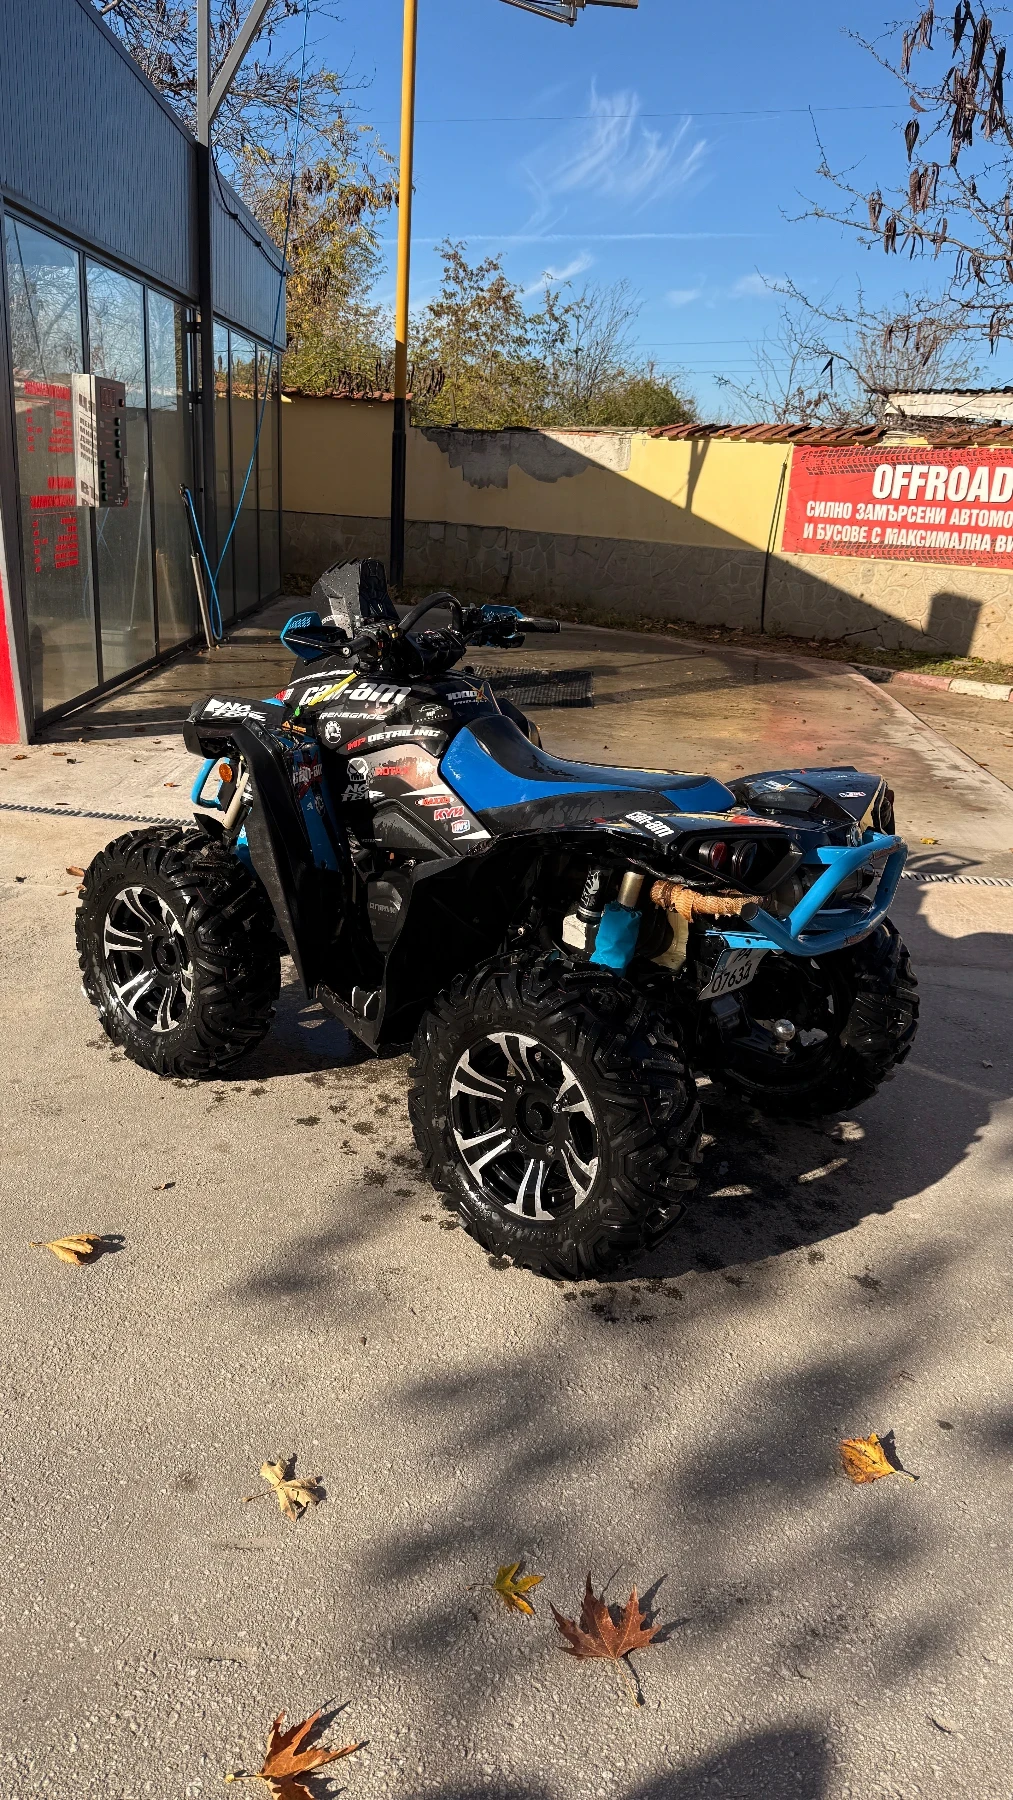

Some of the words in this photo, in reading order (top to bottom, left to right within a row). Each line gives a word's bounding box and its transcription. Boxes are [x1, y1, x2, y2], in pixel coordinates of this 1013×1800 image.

[872, 463, 1013, 502] OFFROAD
[806, 500, 852, 519] СИЛНО
[855, 503, 947, 525] ЗАМЪРСЕНИ
[949, 508, 1013, 529] АВТОМО
[803, 523, 814, 539] И
[816, 523, 869, 543] БУСОВЕ
[871, 527, 882, 544] С
[884, 528, 991, 552] МАКСИМАЛНА
[319, 712, 388, 720] RENEGADE
[367, 729, 440, 743] DETAILING
[345, 784, 369, 794] NO
[434, 807, 464, 820] KYB
[625, 811, 675, 838] can-am
